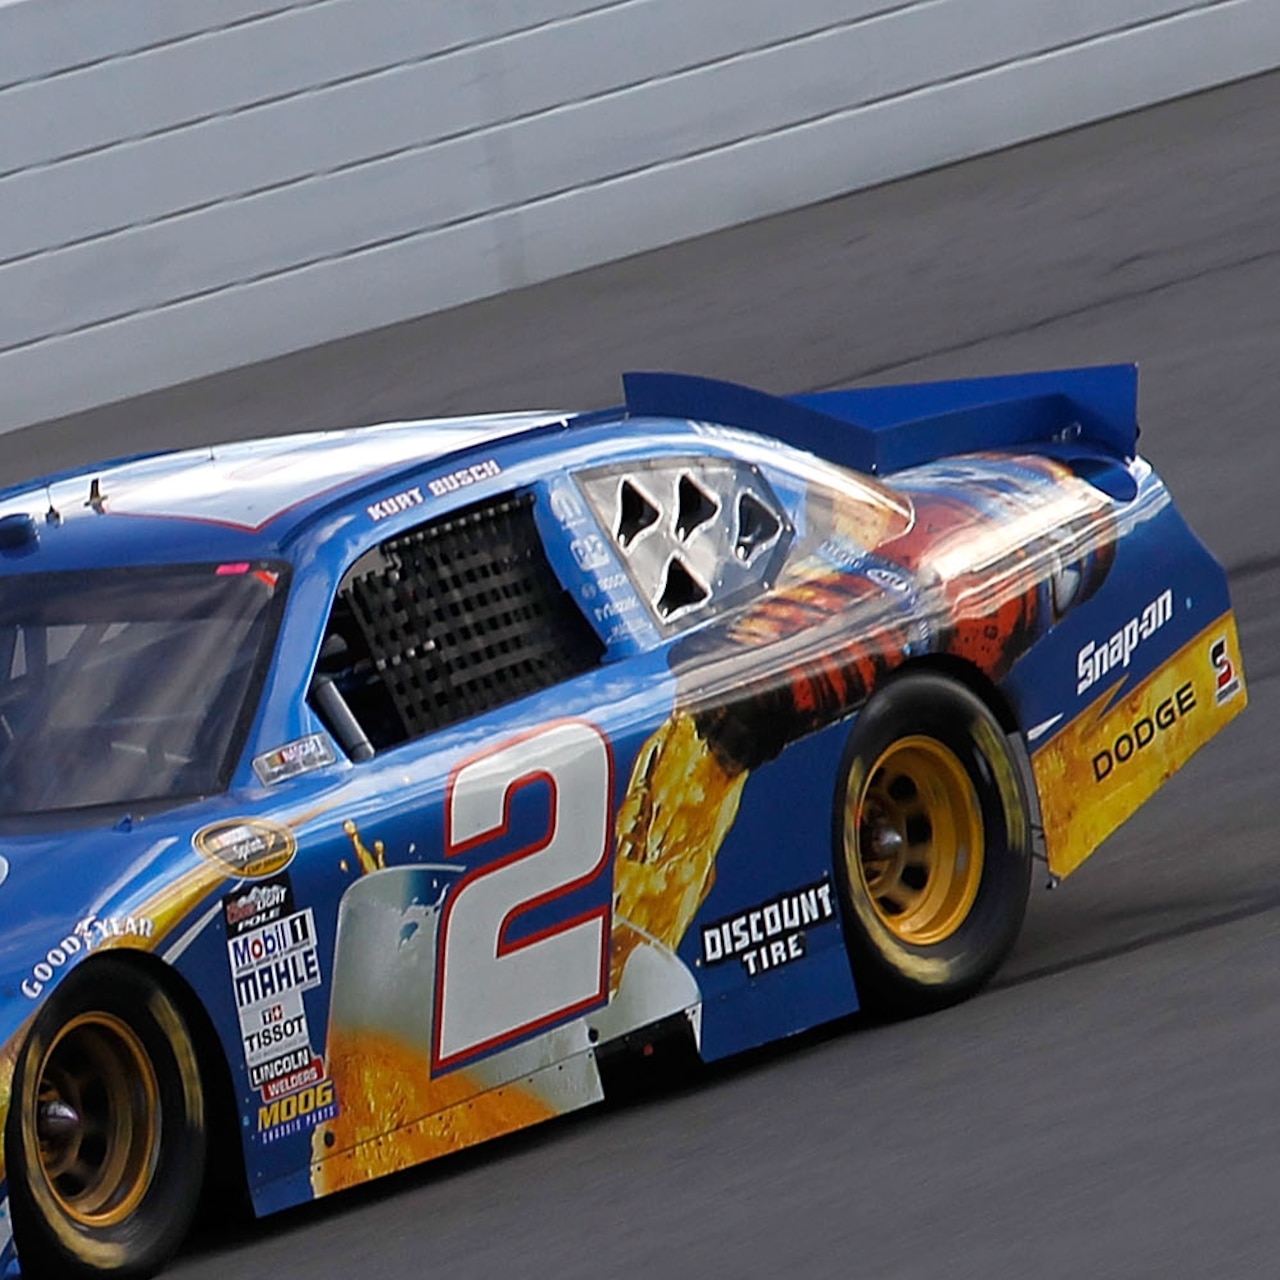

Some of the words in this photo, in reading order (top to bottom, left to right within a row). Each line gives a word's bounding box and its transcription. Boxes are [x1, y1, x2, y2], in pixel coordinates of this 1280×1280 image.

[367, 487, 424, 521] KURT
[428, 459, 502, 497] BUSCH
[1077, 588, 1173, 696] Snap-on
[1092, 681, 1198, 783] DODGE
[434, 717, 613, 1070] 2
[232, 922, 287, 967] Mobil
[292, 916, 307, 942] 1
[238, 907, 281, 932] POLE
[704, 883, 833, 962] DISCOUNT
[235, 949, 318, 1007] MAHLE
[743, 933, 803, 975] TIRE
[245, 1015, 304, 1052] TISSOT
[252, 1048, 309, 1086] LINCOLN
[268, 1067, 318, 1097] WELDERS
[258, 1080, 333, 1132] MOOG
[306, 1105, 335, 1127] PARTS
